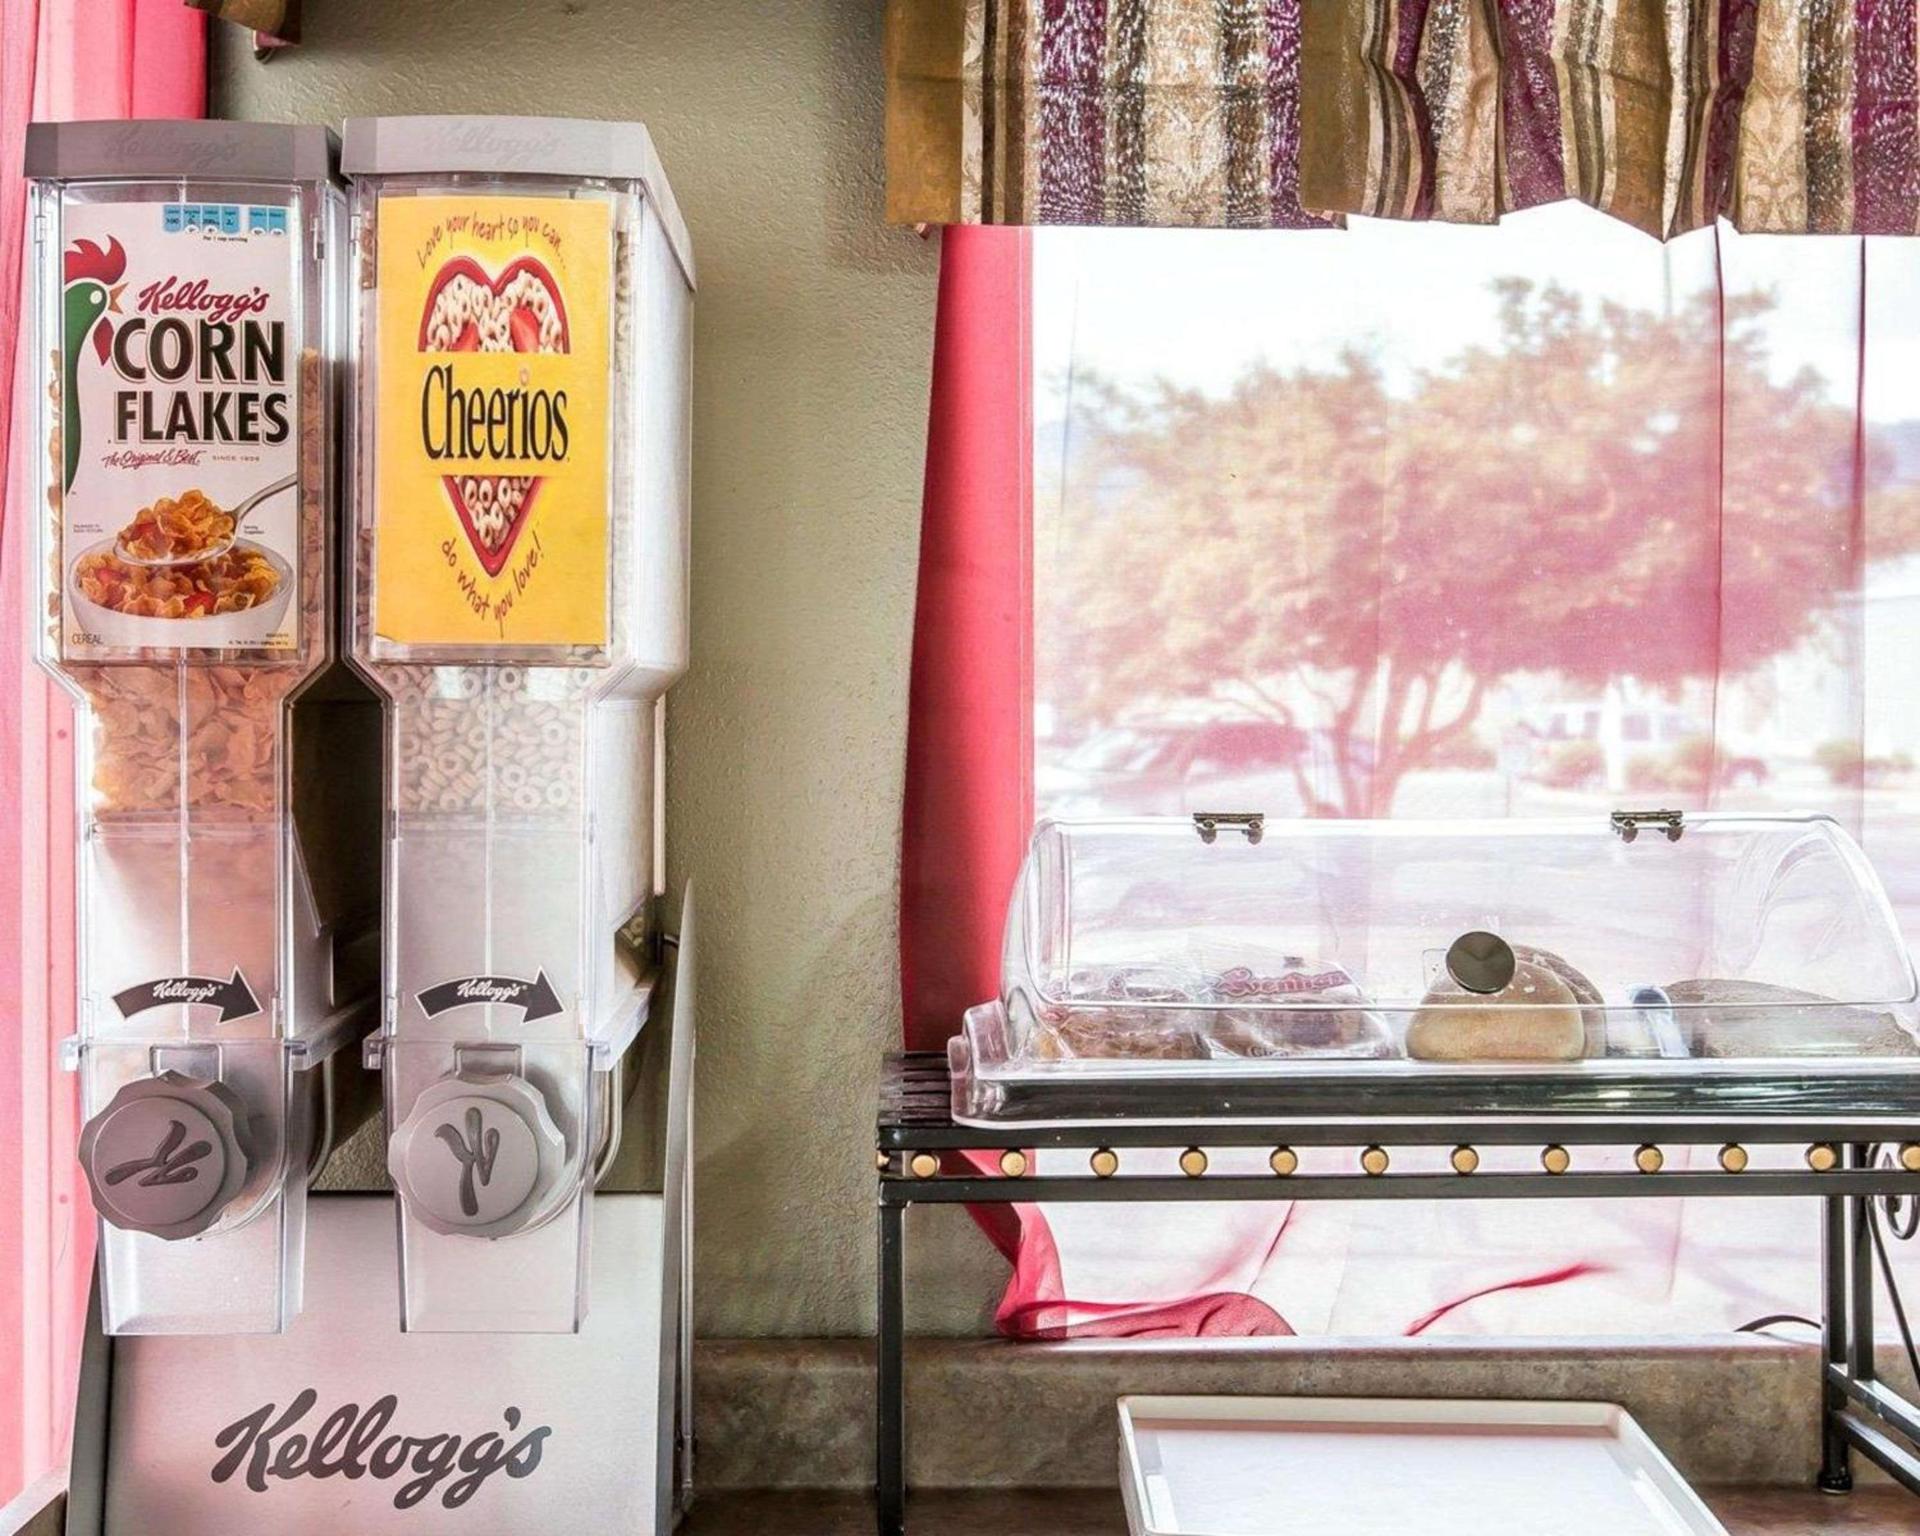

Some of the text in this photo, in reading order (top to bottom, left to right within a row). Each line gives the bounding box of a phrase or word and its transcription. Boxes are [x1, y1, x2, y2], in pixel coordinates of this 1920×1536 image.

[417, 225, 443, 270] Love
[446, 215, 470, 250] your
[472, 211, 505, 241] heart
[507, 216, 519, 240] so
[522, 215, 540, 249] you
[138, 276, 269, 323] Kellogg's
[113, 318, 285, 385] CORN
[115, 391, 290, 444] FLAKES
[421, 363, 569, 461] Cheerios
[101, 451, 118, 470] The
[119, 449, 164, 470] Original
[441, 529, 544, 639] do what you love!
[71, 633, 103, 646] CEREAL
[152, 979, 217, 1002] Kellogg's
[457, 978, 521, 1002] Kellogg's
[211, 1388, 553, 1509] Kellogg's
